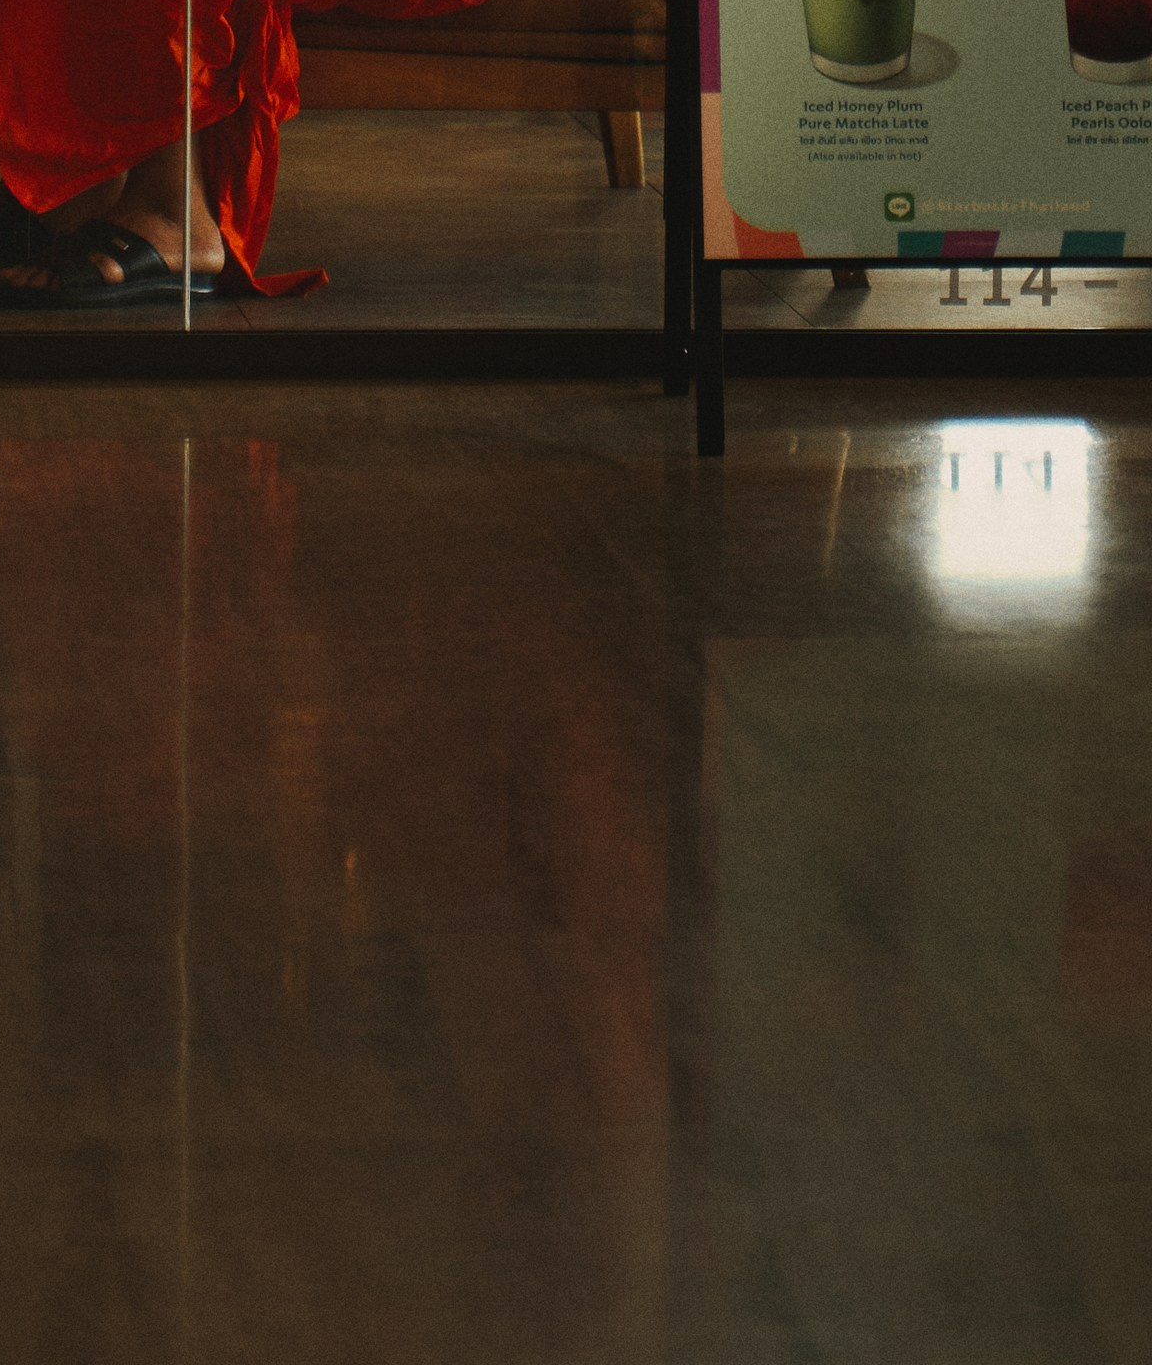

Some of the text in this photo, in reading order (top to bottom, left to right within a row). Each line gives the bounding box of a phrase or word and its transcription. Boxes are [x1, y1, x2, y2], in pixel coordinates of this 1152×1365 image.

[804, 100, 923, 114] Iced Honey Plum
[1062, 100, 1092, 112] Iced
[1096, 100, 1138, 112] Peach
[799, 117, 929, 129] Pure Matcha Latte
[1071, 117, 1115, 128] Pearls
[808, 151, 922, 163] (Also available in hot)
